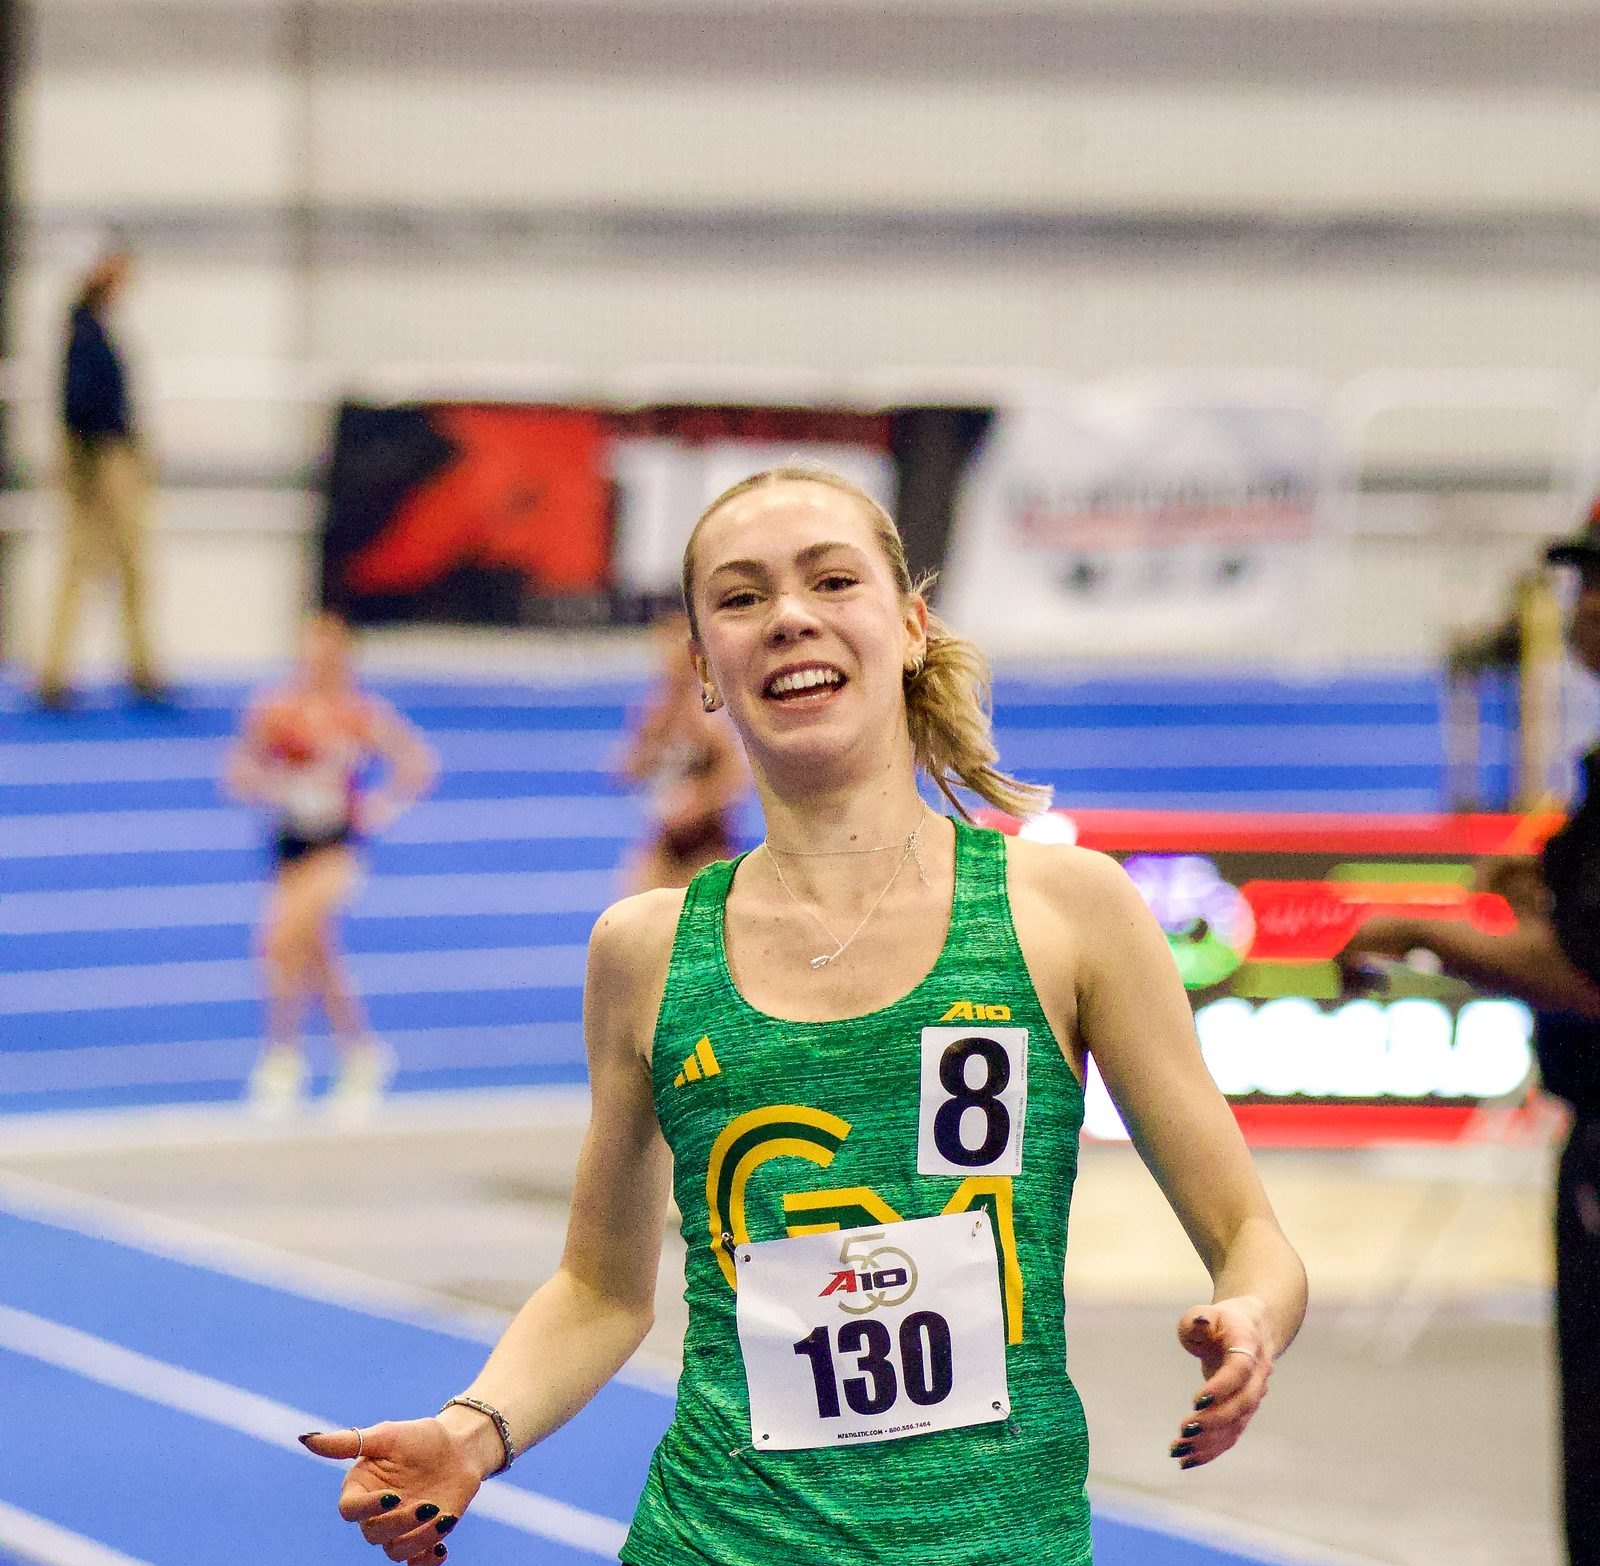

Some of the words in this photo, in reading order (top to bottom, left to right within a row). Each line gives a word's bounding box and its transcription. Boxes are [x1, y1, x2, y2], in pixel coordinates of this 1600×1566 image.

[940, 1001, 1011, 1021] A10
[934, 1037, 1010, 1166] 8
[818, 1267, 908, 1297] A10
[793, 1310, 953, 1419] 130
